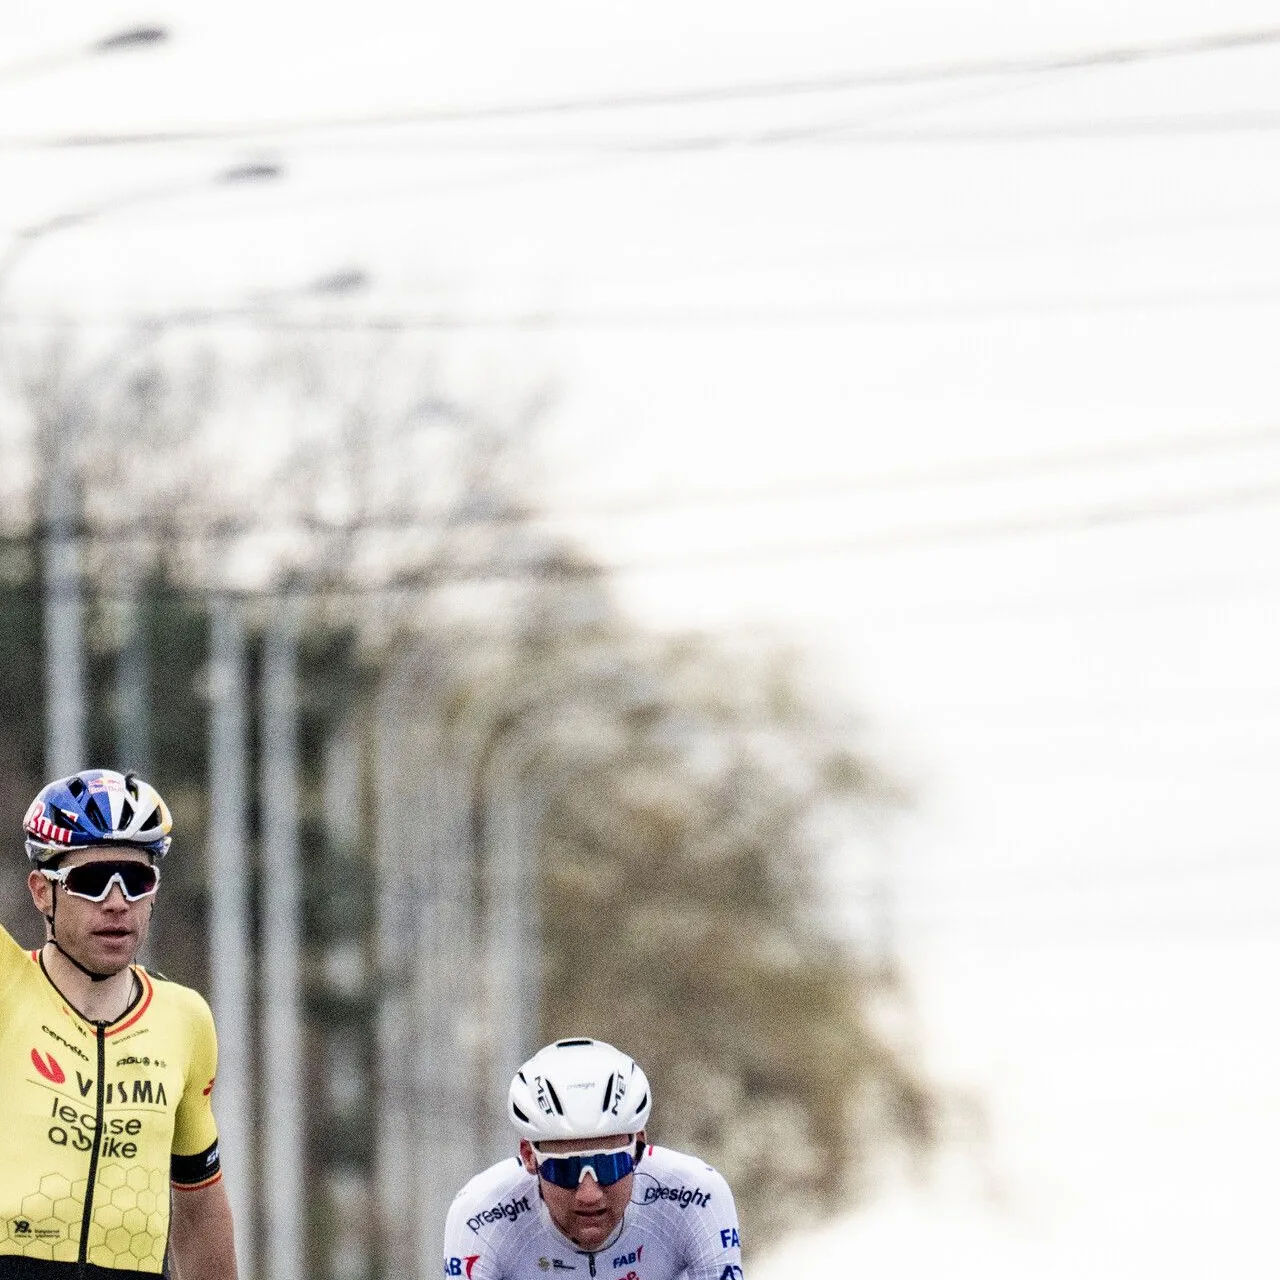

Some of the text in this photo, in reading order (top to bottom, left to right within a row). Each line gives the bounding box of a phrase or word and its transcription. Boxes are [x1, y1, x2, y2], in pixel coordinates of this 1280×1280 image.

[76, 1070, 168, 1107] VISMA
[51, 1097, 142, 1136] lease
[466, 1195, 532, 1235] presight
[644, 1185, 712, 1209] presight
[613, 1253, 636, 1269] FAB
